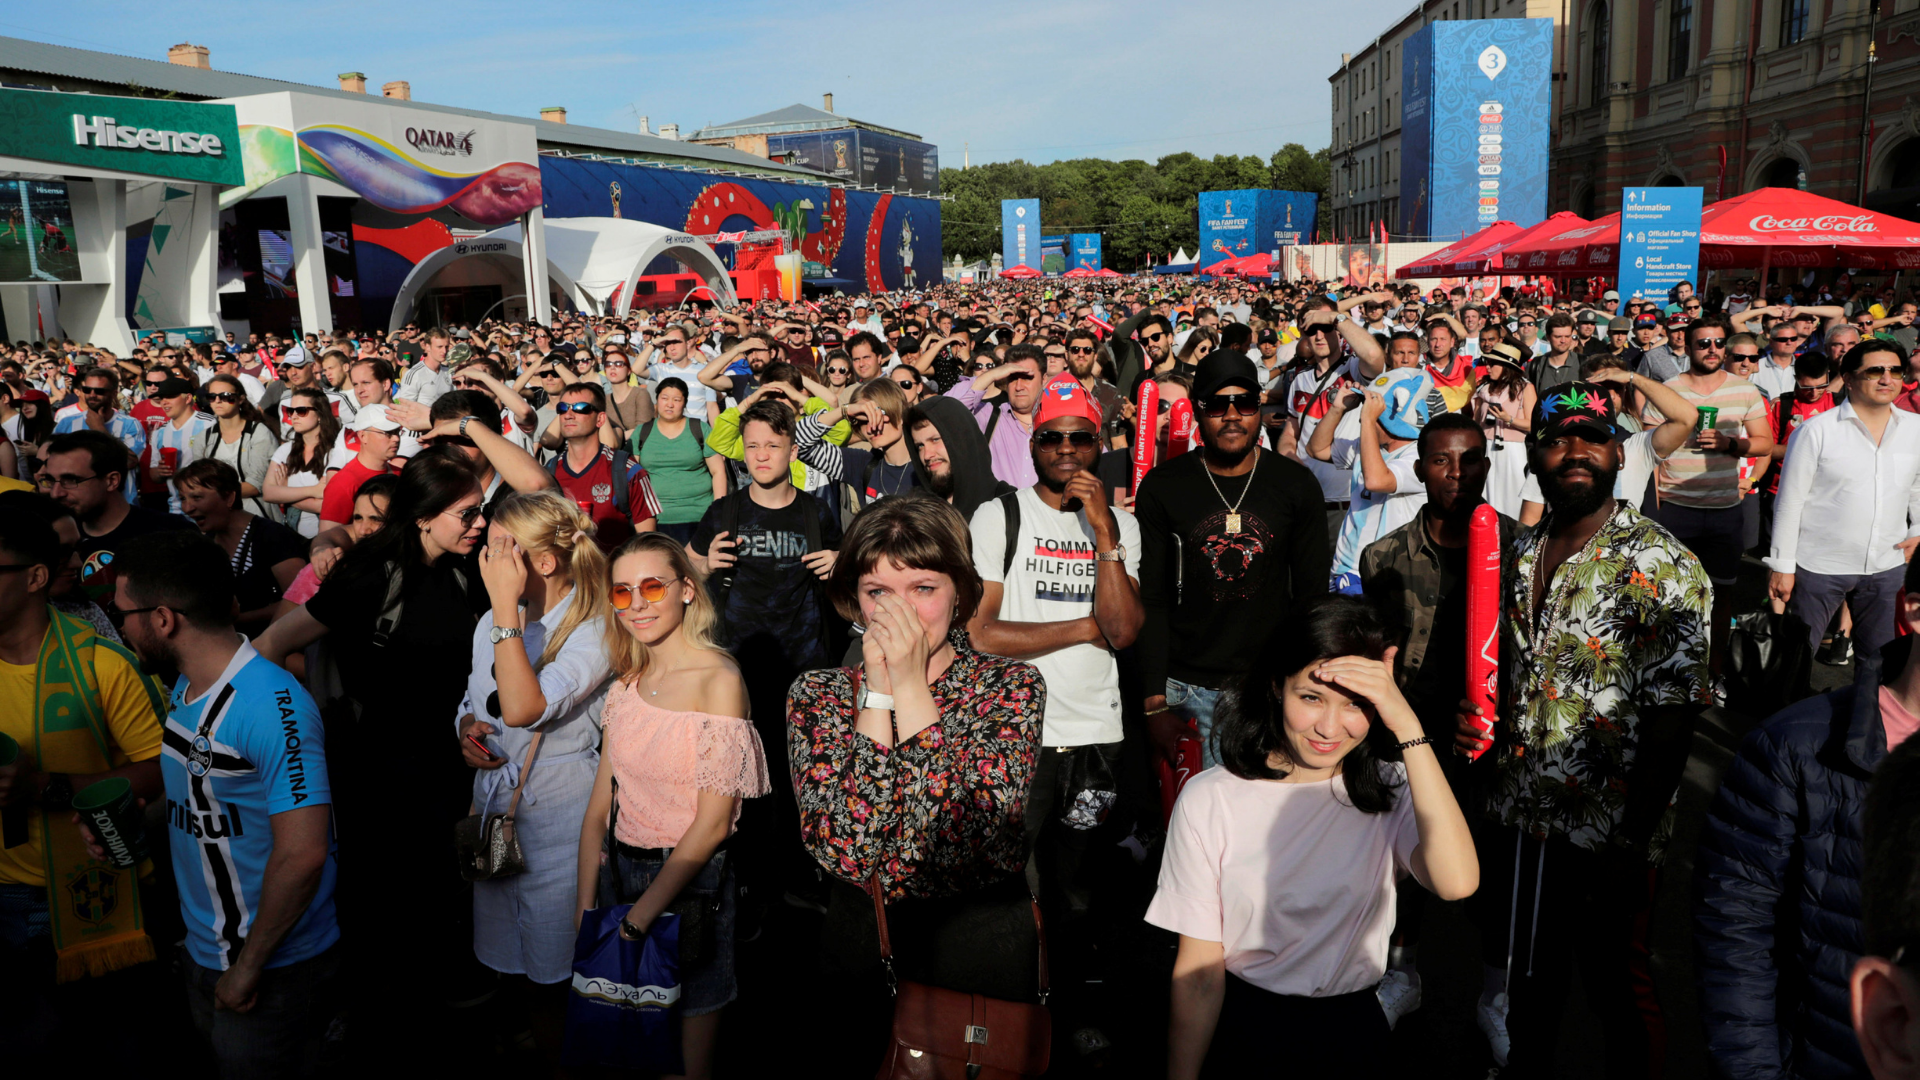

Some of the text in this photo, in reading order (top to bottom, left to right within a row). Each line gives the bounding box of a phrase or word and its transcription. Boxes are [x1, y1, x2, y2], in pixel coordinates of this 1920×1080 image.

[1486, 53, 1499, 69] 3
[73, 114, 222, 155] Hisense
[405, 127, 455, 149] QATAR
[36, 186, 64, 194] Hisense
[1626, 203, 1671, 211] Information
[1749, 214, 1878, 233] Coca-Cola
[471, 243, 507, 252] HYUNDAI
[1137, 382, 1152, 461] SAINT-PETERSBURG
[737, 530, 808, 559] DENIM
[1033, 536, 1096, 554] TOMMY
[1026, 558, 1095, 577] HILFIGE
[1035, 580, 1095, 598] DENIM
[274, 688, 308, 805] TRAMONTINA
[92, 810, 134, 866] КЛИНСКОЕ
